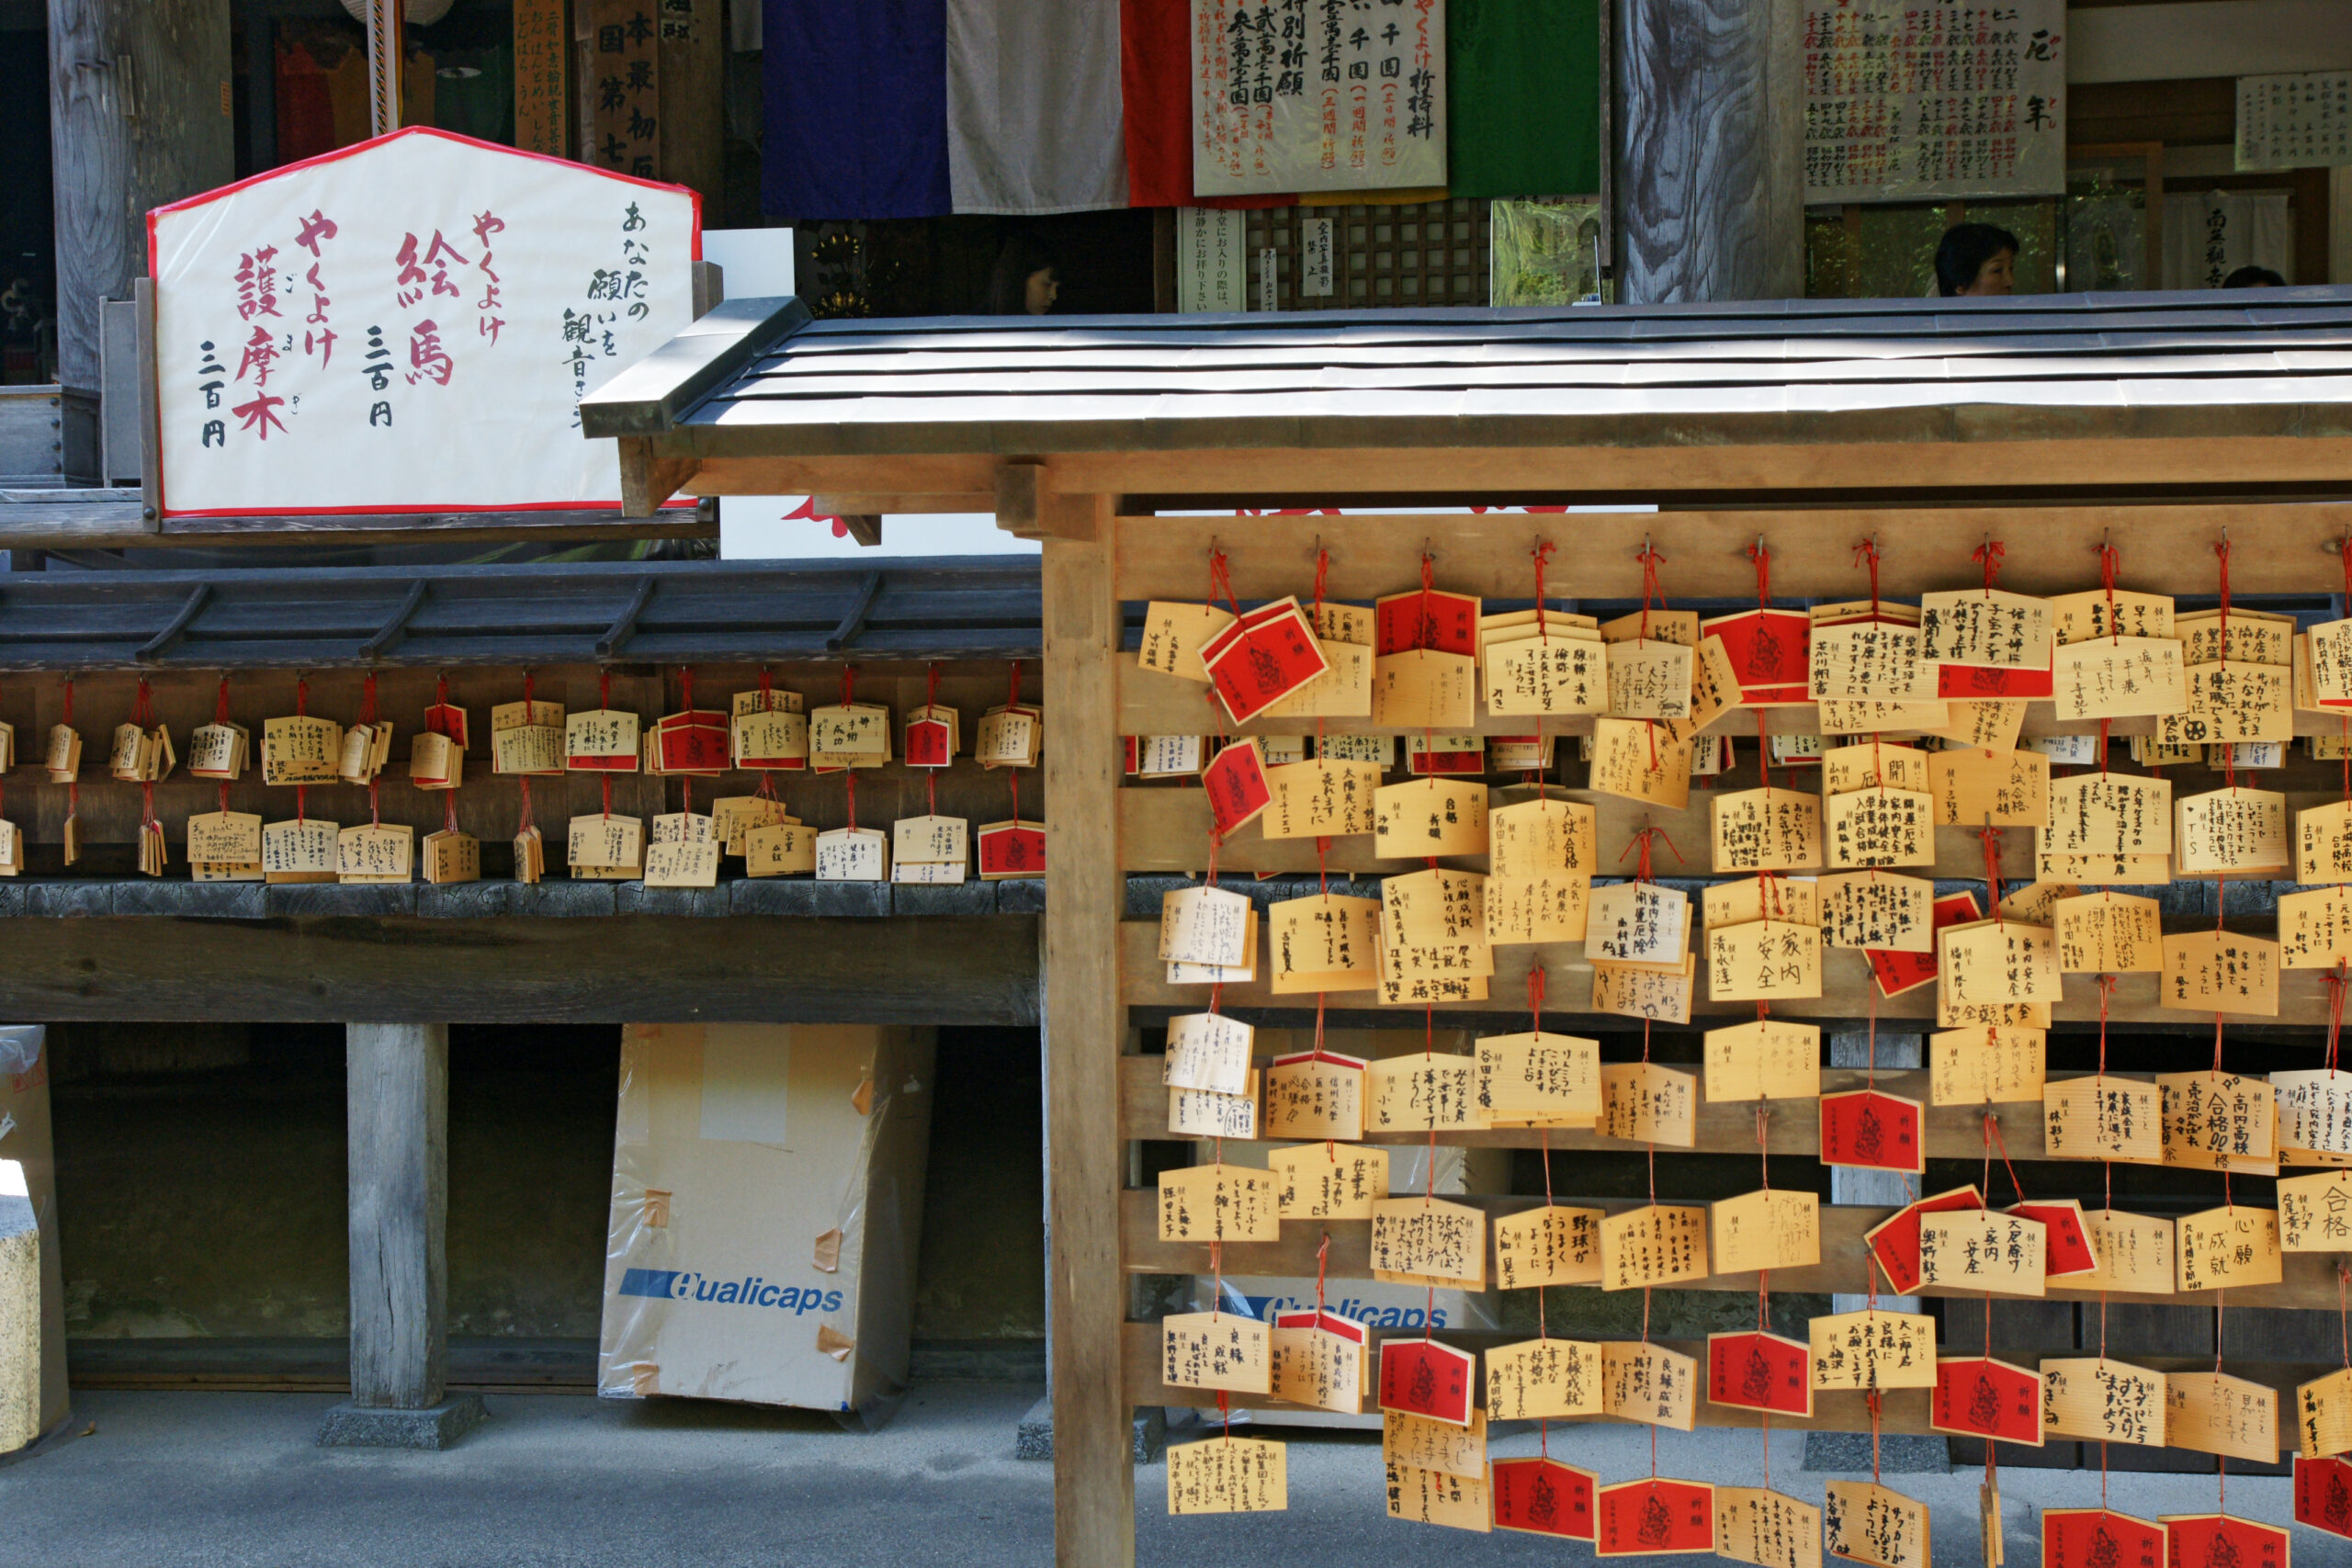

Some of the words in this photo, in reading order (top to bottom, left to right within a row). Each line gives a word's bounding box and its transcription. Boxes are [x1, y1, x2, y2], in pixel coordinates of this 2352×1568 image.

[471, 209, 507, 349] やくよけ
[621, 200, 650, 323] あなたの
[294, 209, 339, 370] やくよけ
[394, 228, 470, 388] 絵馬
[586, 269, 618, 357] 願いを
[232, 243, 289, 441] 護摩木
[198, 339, 228, 448] 三百円
[362, 324, 394, 428] 三百円
[1456, 611, 1468, 640] 祈願
[1444, 797, 1457, 824] 合格
[1562, 806, 1578, 869] 入試合格
[1890, 796, 1904, 853] 家内安全
[1903, 798, 1918, 857] 開運厄除
[1647, 891, 1660, 949] 家内安全
[1757, 935, 1778, 989] 安全
[1780, 928, 1802, 986] 家内
[1898, 1113, 1911, 1145] 祈願
[1555, 1217, 1567, 1264] うまく
[1571, 1215, 1589, 1264] 野球が
[2321, 1187, 2351, 1240] 合格
[1530, 1228, 1541, 1269] ように
[2209, 1230, 2230, 1276] 成就
[2233, 1218, 2255, 1266] 心願
[670, 1271, 843, 1315] Qualicaps
[2018, 1385, 2030, 1418] 祈願
[1574, 1483, 1587, 1515] 祈願
[1690, 1496, 1704, 1527] 祈願
